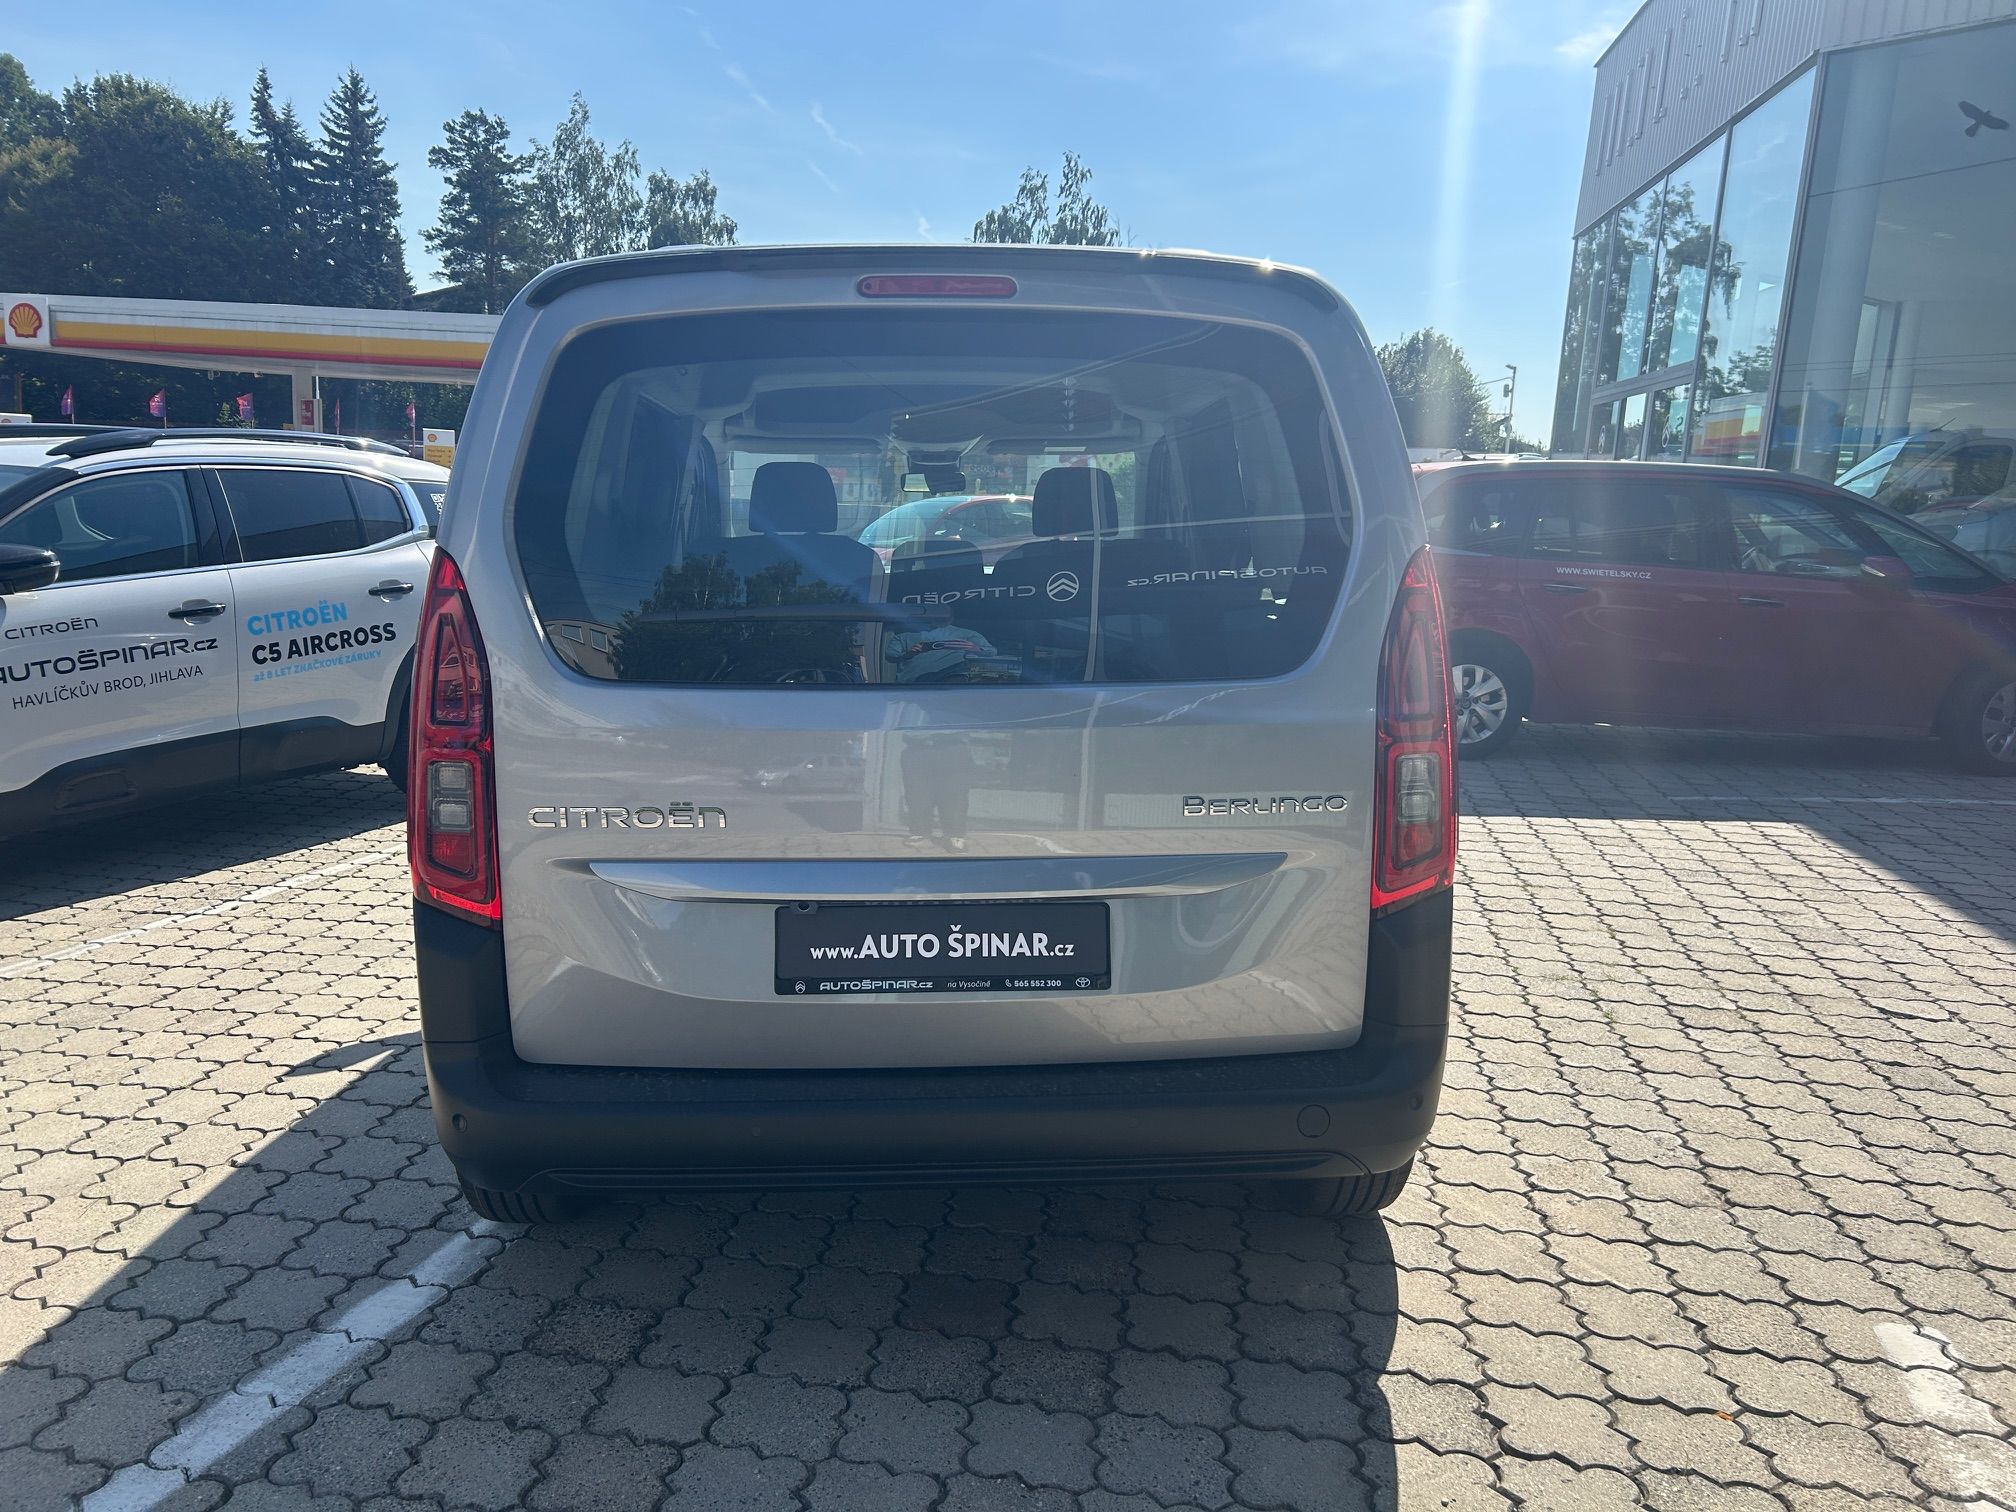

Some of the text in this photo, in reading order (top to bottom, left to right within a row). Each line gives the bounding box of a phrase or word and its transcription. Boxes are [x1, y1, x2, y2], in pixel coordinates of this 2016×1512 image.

[1556, 566, 1652, 579] WWW.SWIETELSKY.CZ
[4, 617, 99, 640] CITROËN
[246, 600, 348, 636] CITROËN
[251, 622, 397, 665] C5 AIRCROSS
[274, 664, 292, 678] LET
[345, 649, 382, 664] ZÁRUKY
[12, 664, 204, 710] HAVLÍČKŮV BROD, JIHLAVA
[527, 801, 727, 829] CITROËN
[809, 924, 1075, 960] www.AUTO ŠPINAR.cz
